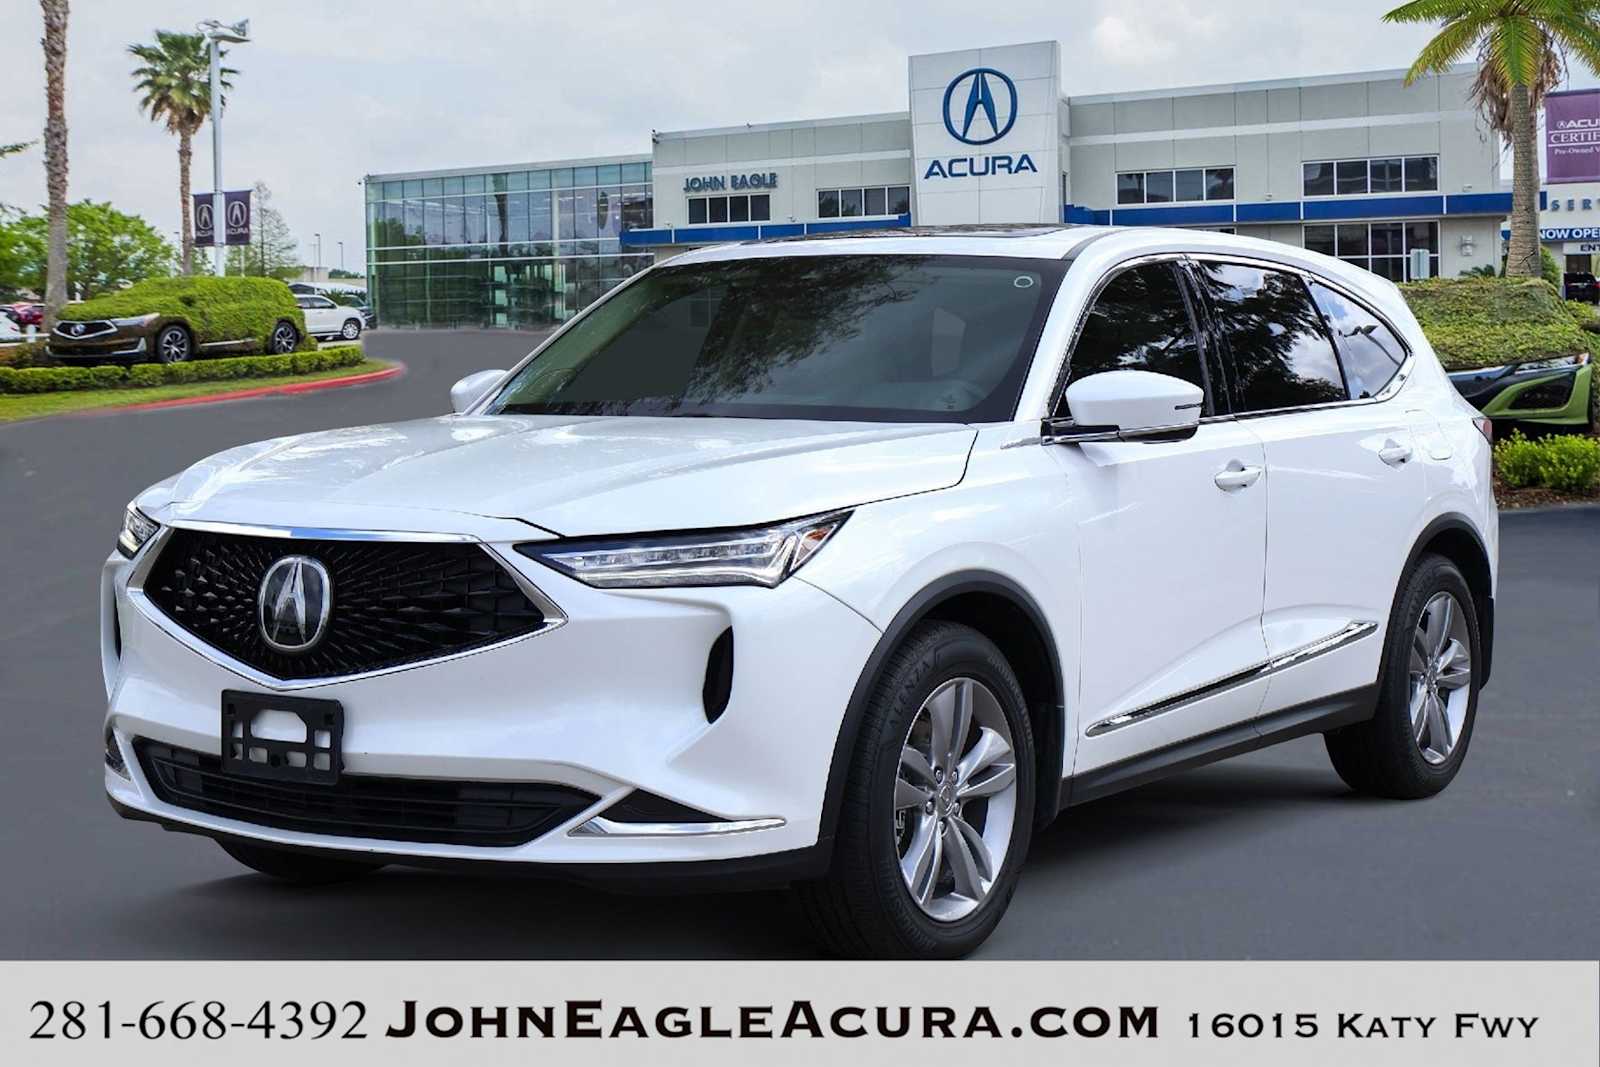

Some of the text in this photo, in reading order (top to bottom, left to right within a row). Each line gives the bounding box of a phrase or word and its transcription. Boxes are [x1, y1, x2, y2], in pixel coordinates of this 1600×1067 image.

[1566, 119, 1600, 128] ACU
[924, 154, 1038, 179] ACURA
[683, 173, 778, 192] JOHN EAGLE
[1539, 228, 1600, 239] NOW OPE
